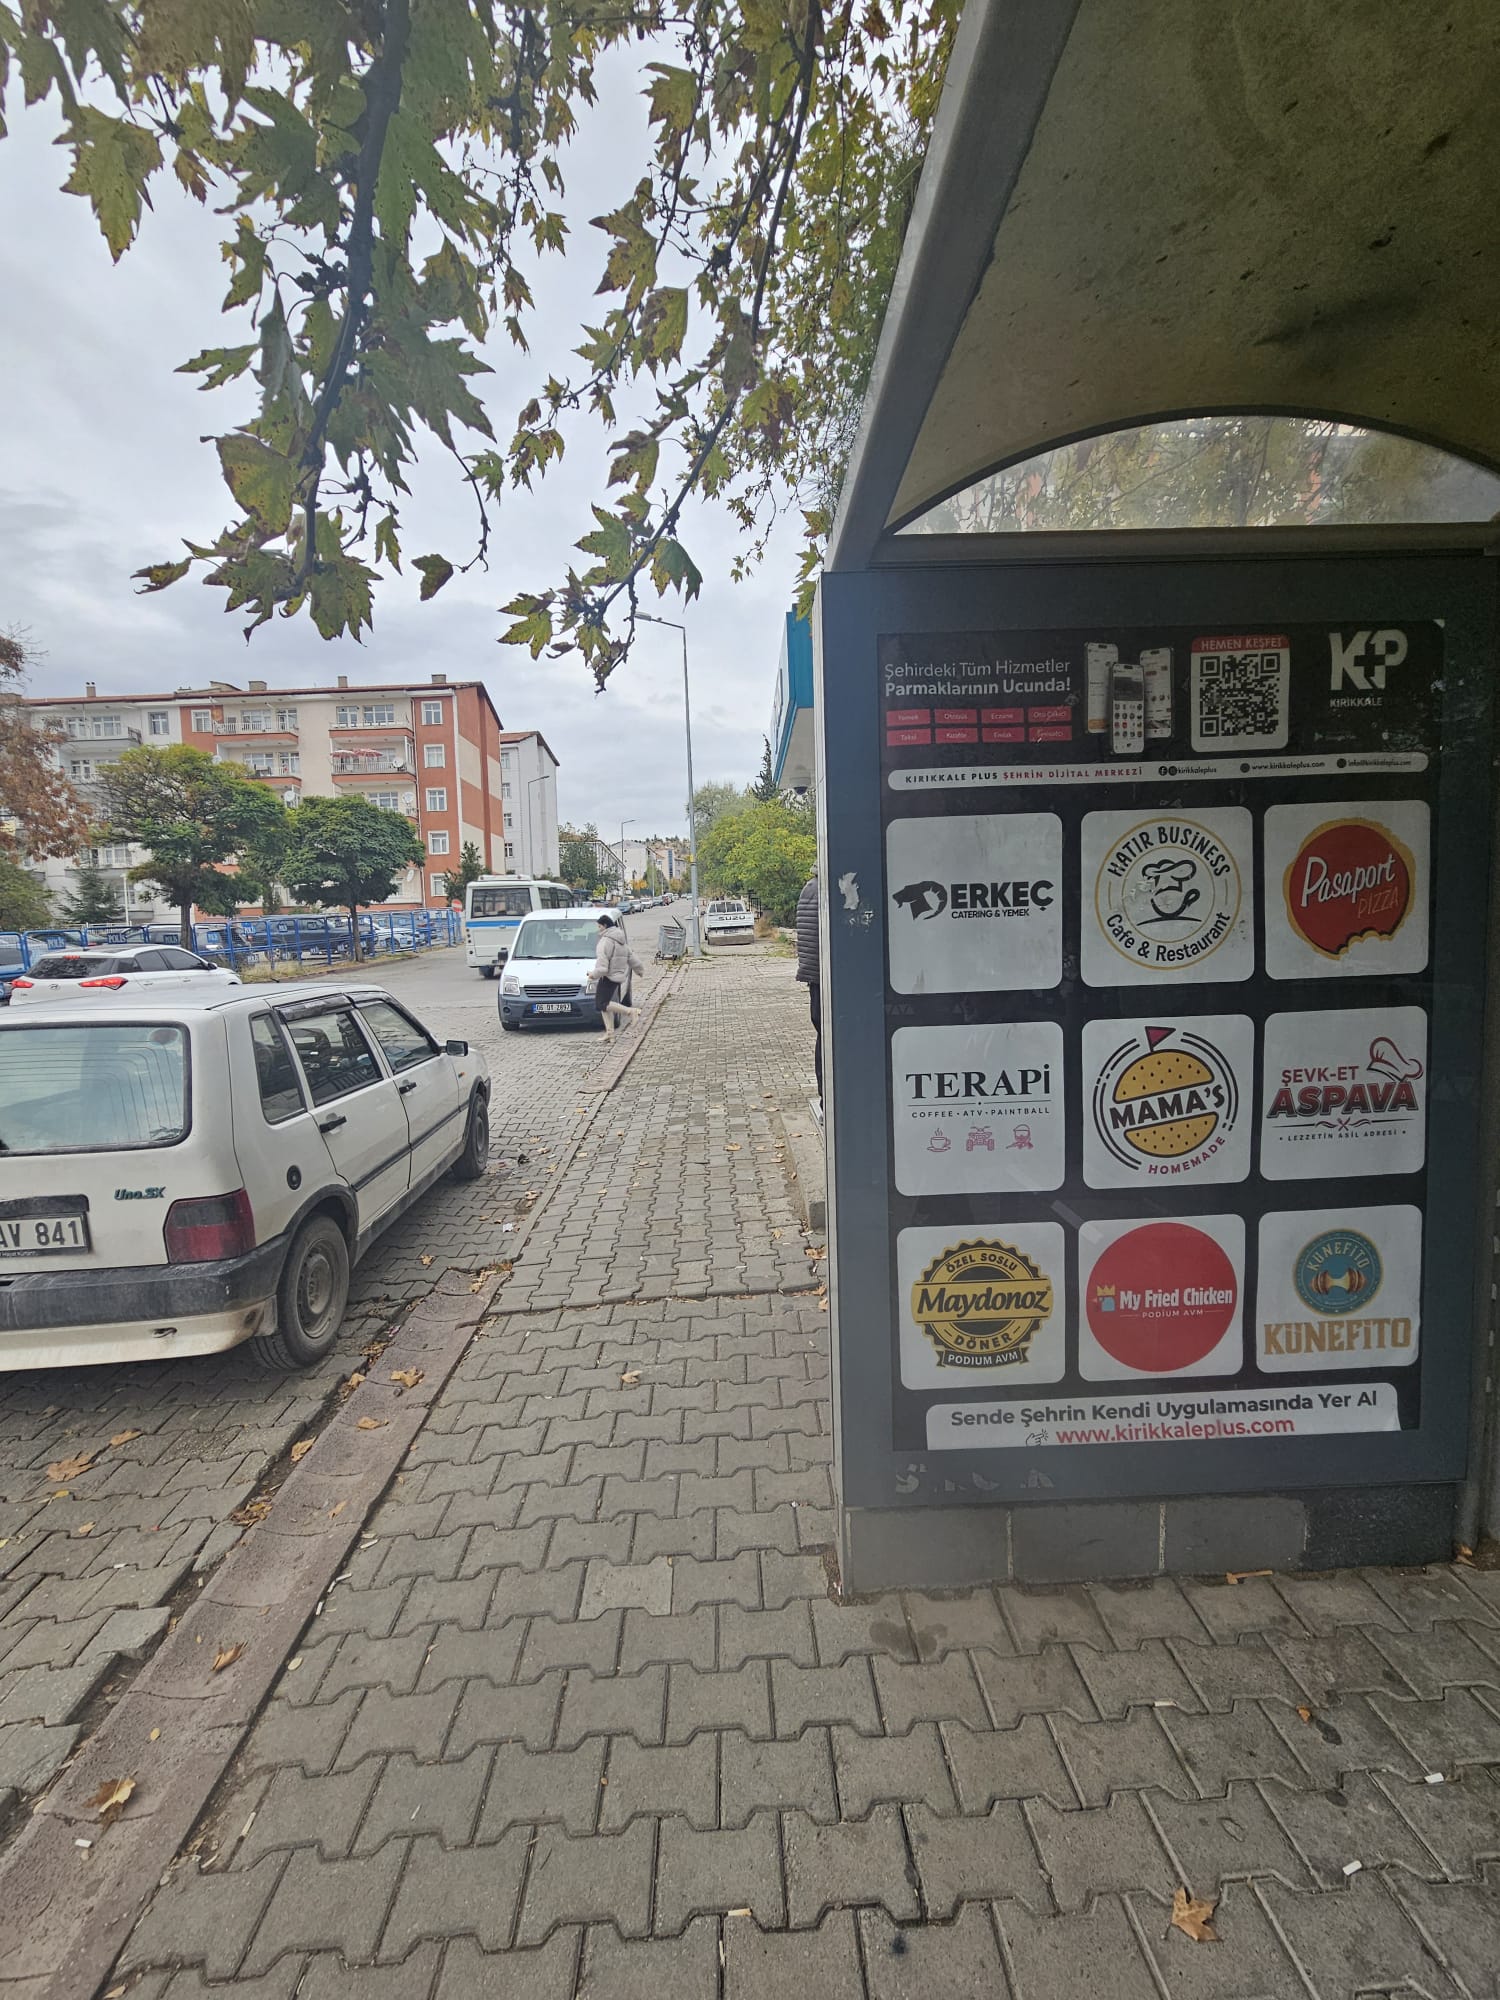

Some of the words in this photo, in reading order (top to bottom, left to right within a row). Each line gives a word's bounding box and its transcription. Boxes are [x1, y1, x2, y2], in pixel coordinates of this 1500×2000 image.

[1201, 639, 1242, 651] HEMEN
[1245, 637, 1283, 650] KEŞFET
[884, 662, 957, 679] Şehirdeki
[959, 662, 991, 677] Tüm
[995, 658, 1071, 676] Hizmetler
[885, 679, 999, 697] Parmaklarının
[1002, 677, 1071, 693] Ucunda!
[905, 773, 967, 784] KIRIKKALE
[971, 772, 998, 780] PLUS
[1003, 769, 1044, 780] ŞEHRİN
[1094, 767, 1143, 777] MERKEZİ
[1107, 831, 1154, 877] HATIR
[1300, 853, 1396, 908] Pasaport
[950, 880, 1055, 911] ERKEÇ
[951, 910, 993, 919] CATERING
[994, 909, 1001, 918] &
[1002, 908, 1030, 918] YEMEK
[1106, 914, 1135, 949] Cafe
[1137, 941, 1150, 959] &
[1155, 911, 1231, 962] Restaurant
[1281, 1065, 1360, 1087] ŞEVK-ET
[1109, 1084, 1226, 1130] MAMA'S
[1266, 1081, 1419, 1119] ASPAVA
[911, 1110, 954, 1119] COFFEE
[962, 1109, 983, 1117] ATV
[991, 1107, 1051, 1116] PAINTBALL
[1148, 1135, 1226, 1175] HOMEMADE
[35, 1220, 79, 1246] 841
[945, 1254, 976, 1273] ÖZEL
[980, 1252, 1018, 1271] SOSLU
[916, 1286, 1050, 1319] Maydonoz
[1119, 1290, 1141, 1311] My
[1144, 1288, 1180, 1309] Fried
[1183, 1286, 1233, 1307] Chicken
[1183, 1308, 1204, 1317] AVM
[953, 1333, 1013, 1350] DÖNER
[947, 1354, 993, 1366] PODIUM
[995, 1351, 1019, 1364] AVM
[951, 1408, 1016, 1427] Sende
[1020, 1404, 1086, 1428] Şehrin
[1092, 1401, 1151, 1420] Kendi
[1156, 1393, 1314, 1421] Uygulamasında
[1317, 1393, 1352, 1409] Yer
[1356, 1390, 1378, 1406] Al
[1055, 1418, 1296, 1444] www.kirikkaleplus.com
